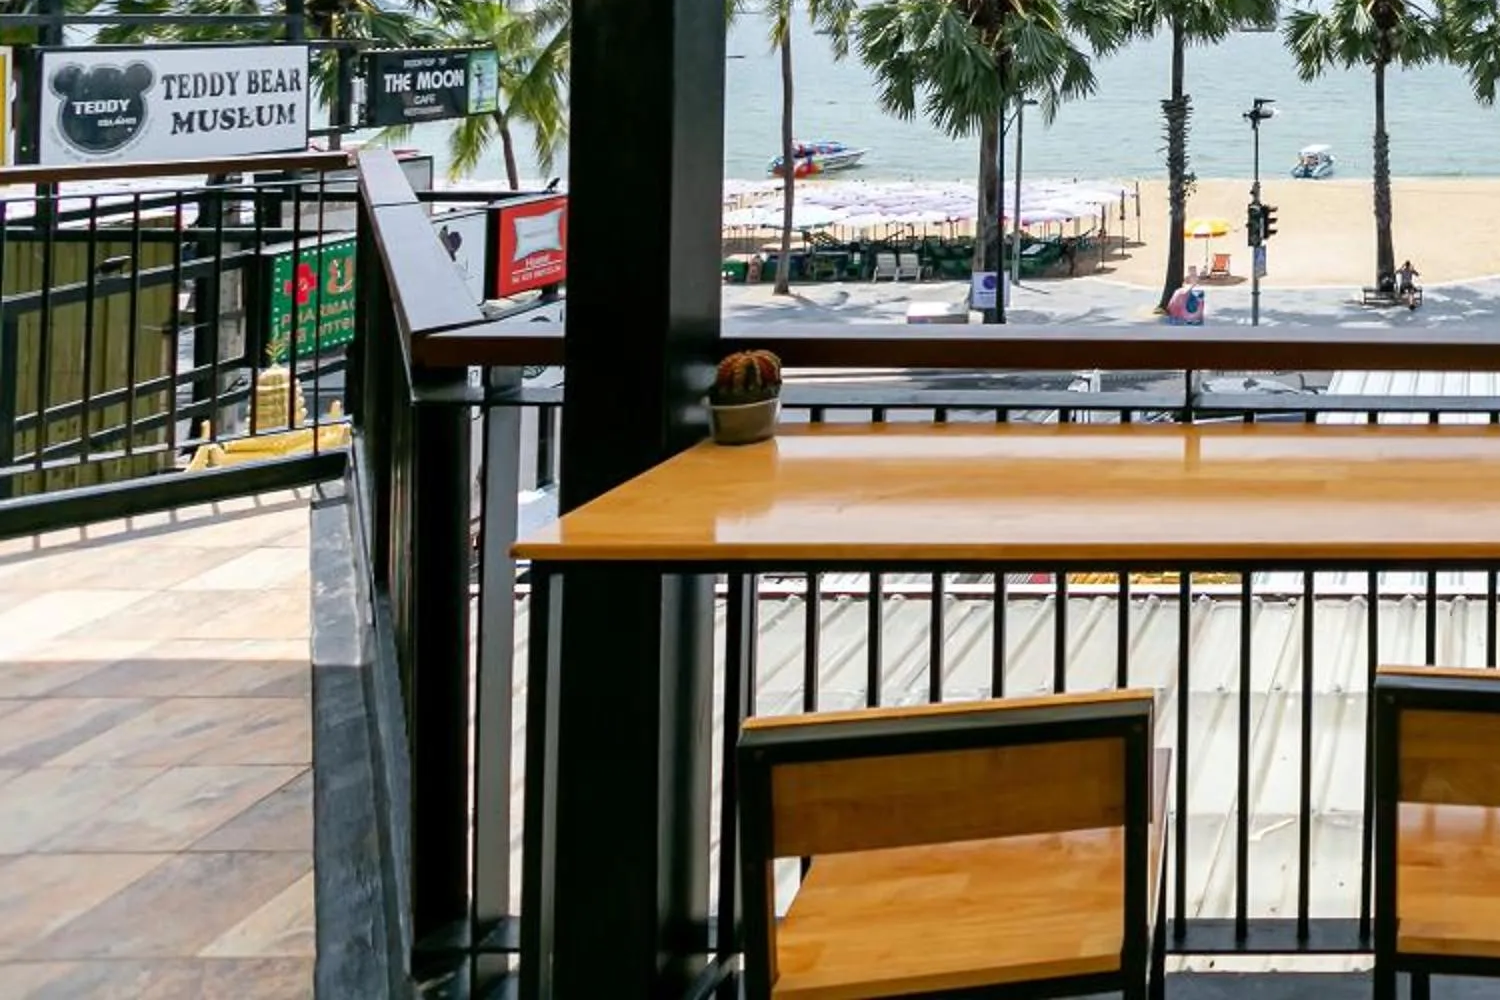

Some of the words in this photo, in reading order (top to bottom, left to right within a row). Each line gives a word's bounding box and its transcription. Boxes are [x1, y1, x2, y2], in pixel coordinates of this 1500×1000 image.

[161, 70, 240, 101] TEDDY
[246, 67, 302, 95] BEAR
[384, 73, 411, 93] THE
[416, 69, 465, 91] MOON
[72, 99, 131, 115] TEDDY
[171, 103, 296, 135] MUSEUM
